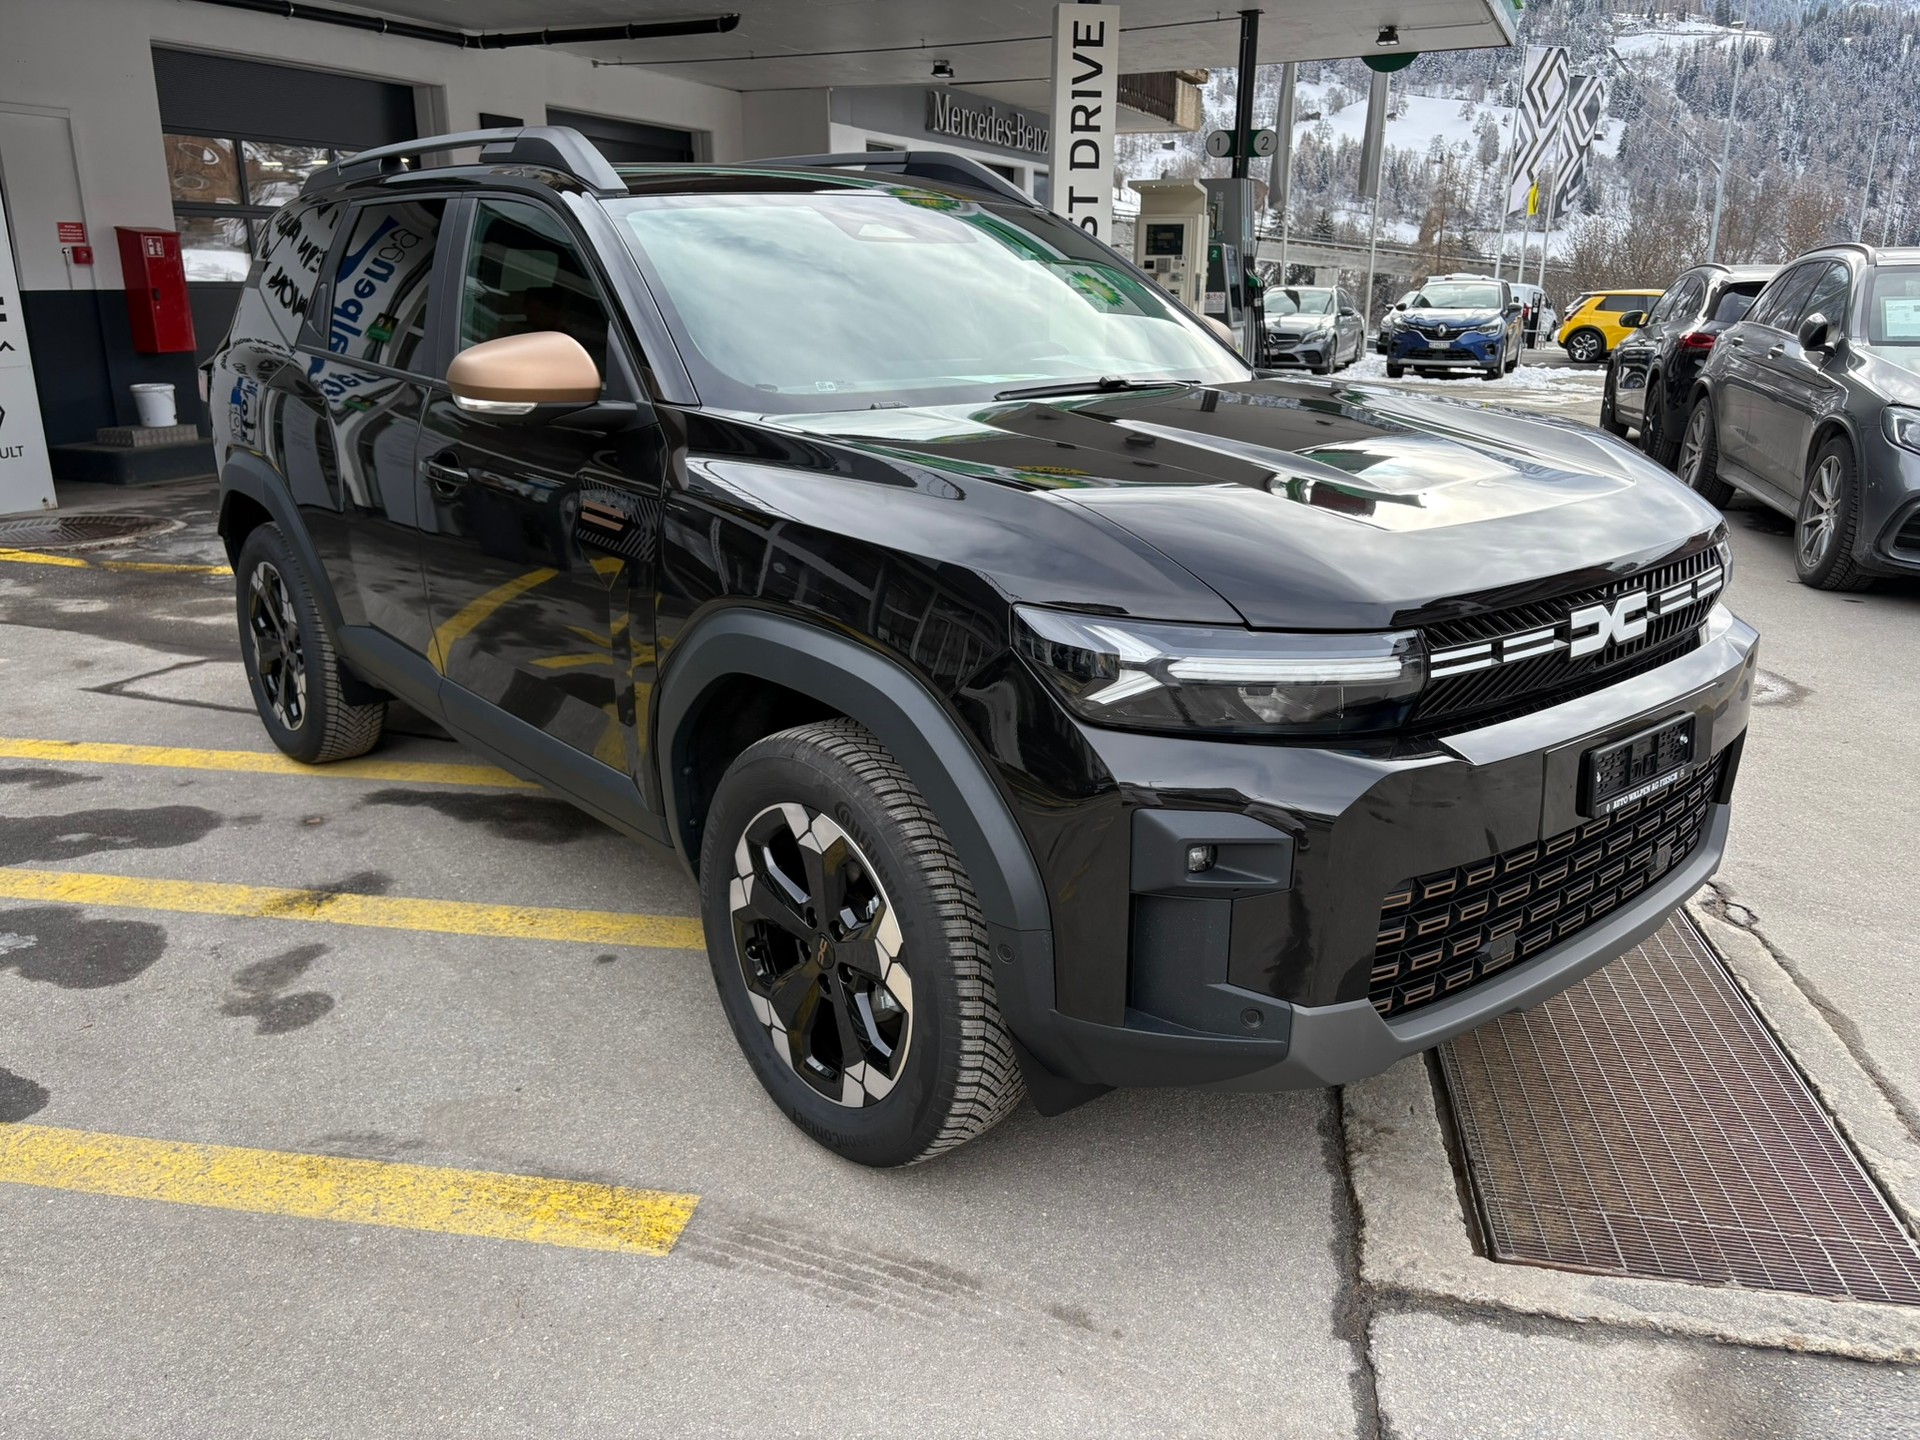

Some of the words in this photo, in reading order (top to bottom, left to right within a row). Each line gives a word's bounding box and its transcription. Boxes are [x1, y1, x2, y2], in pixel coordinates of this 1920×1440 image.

[1069, 20, 1105, 171] DRIVE
[931, 90, 1050, 155] Mercedes-Benz
[1215, 137, 1221, 151] 1
[1261, 136, 1270, 151] 2
[1211, 249, 1218, 259] 2
[1612, 795, 1629, 810] AUTO
